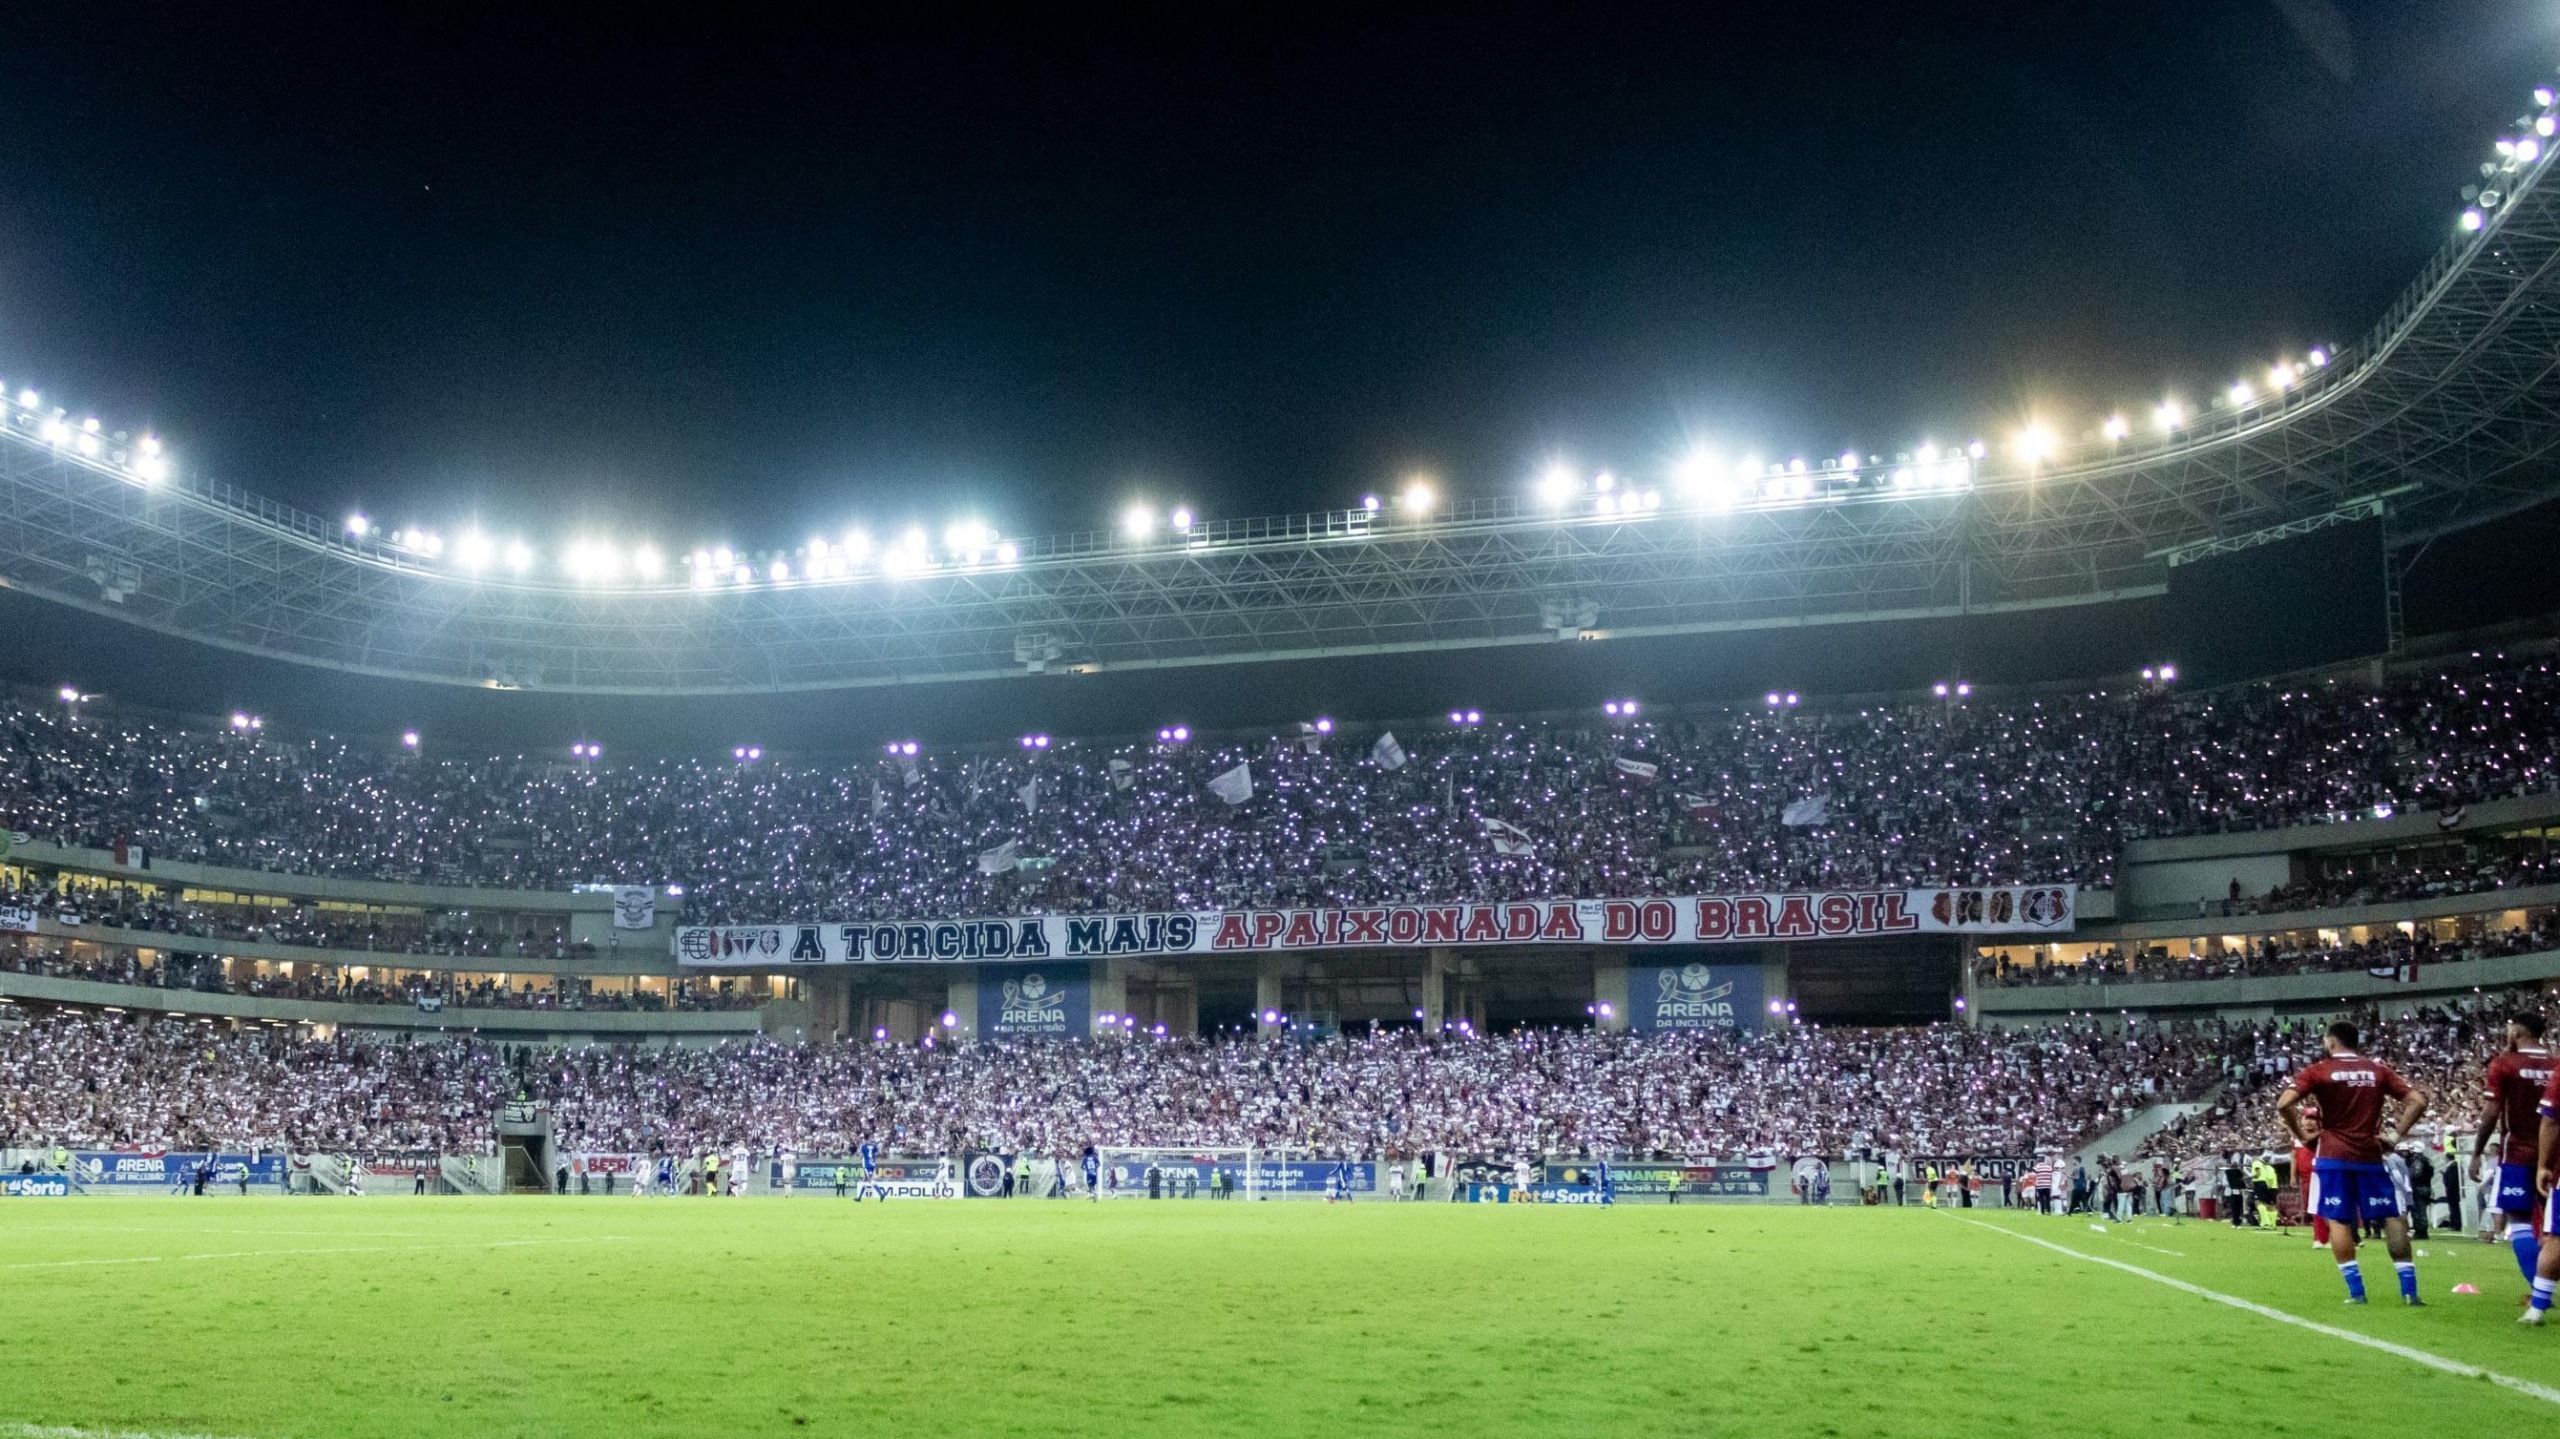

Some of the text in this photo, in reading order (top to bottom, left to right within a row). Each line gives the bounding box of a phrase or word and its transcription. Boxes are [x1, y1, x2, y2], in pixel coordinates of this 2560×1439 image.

[790, 892, 1920, 962] A TORCIDA MAIS APAIXONADA DO BRASIL
[1001, 1009, 1065, 1022] ARENA
[1656, 1003, 1734, 1017] ARENA
[115, 1159, 165, 1172] ARENA
[588, 1157, 628, 1173] BEER
[21, 1179, 65, 1195] Sorte
[1556, 1189, 1604, 1203] Sorte
